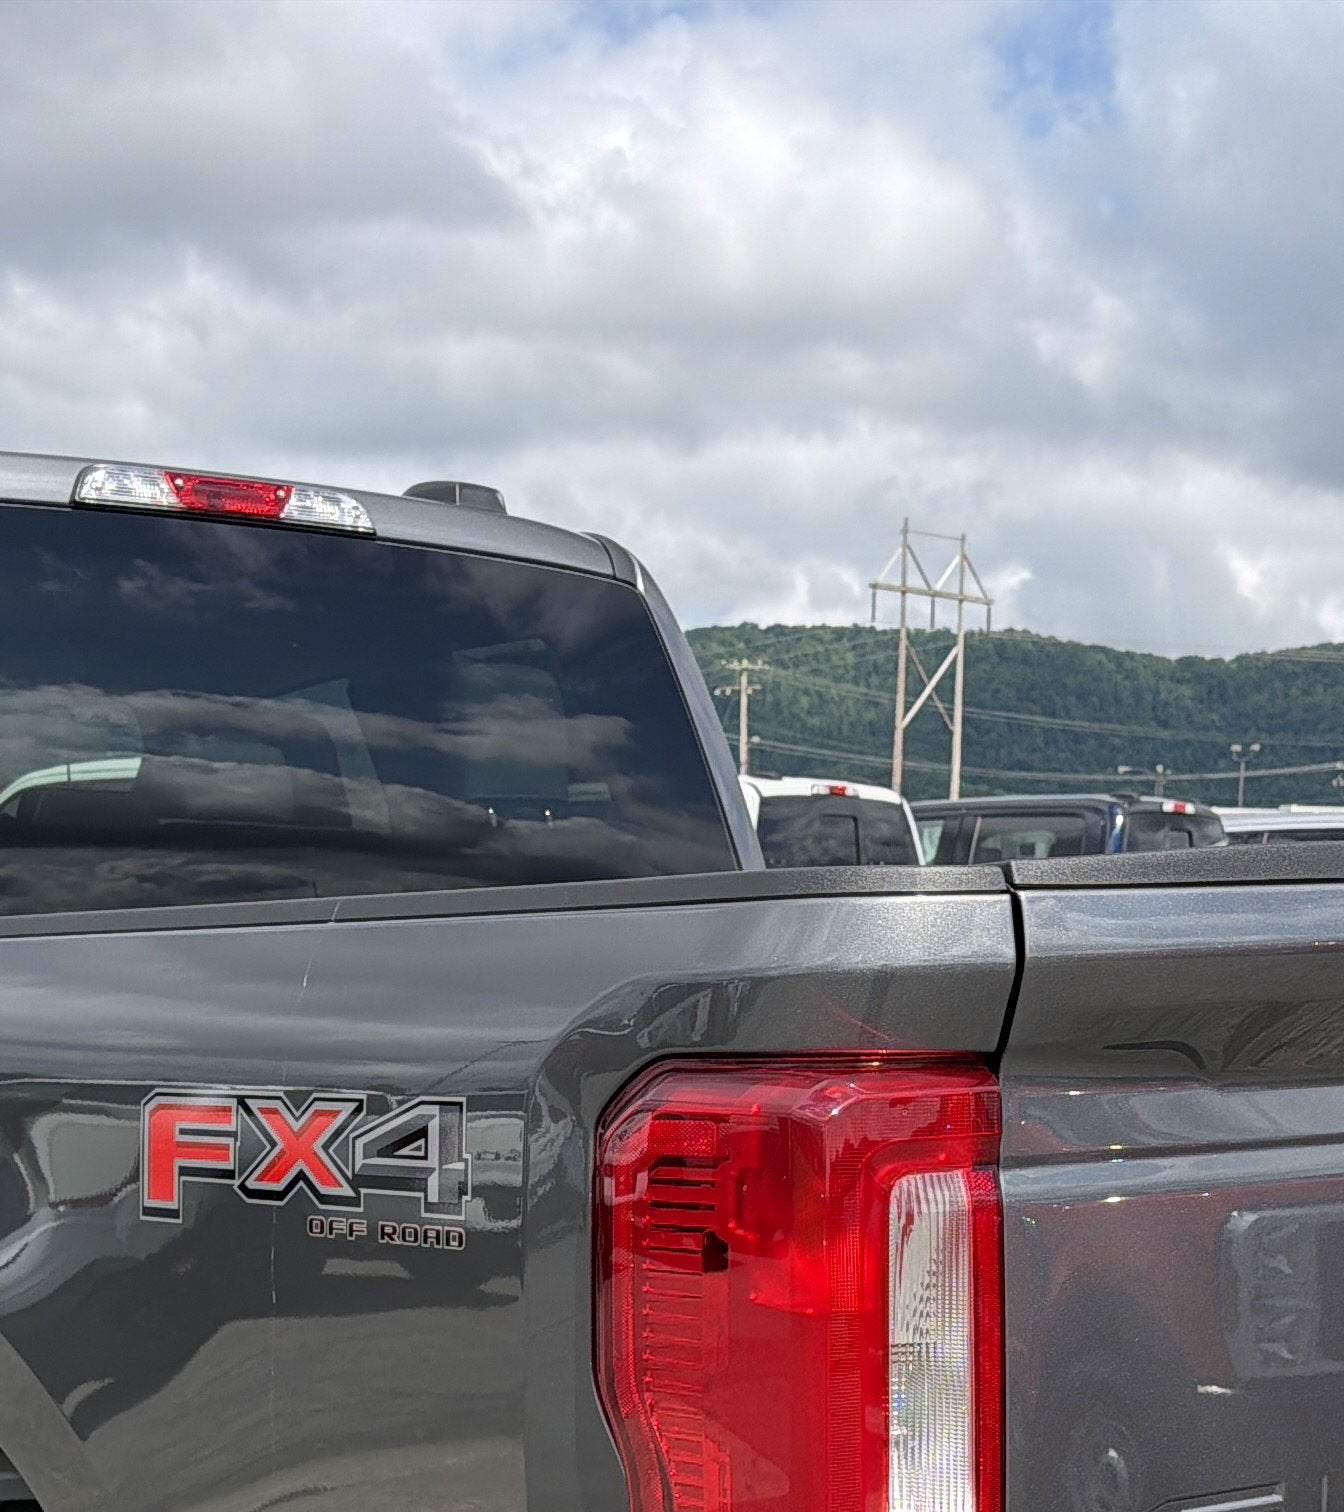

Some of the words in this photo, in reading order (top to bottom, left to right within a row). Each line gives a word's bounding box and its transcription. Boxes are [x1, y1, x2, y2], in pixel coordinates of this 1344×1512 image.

[139, 1087, 472, 1224] FX4
[307, 1215, 368, 1241] OFF
[377, 1221, 467, 1251] ROAD
